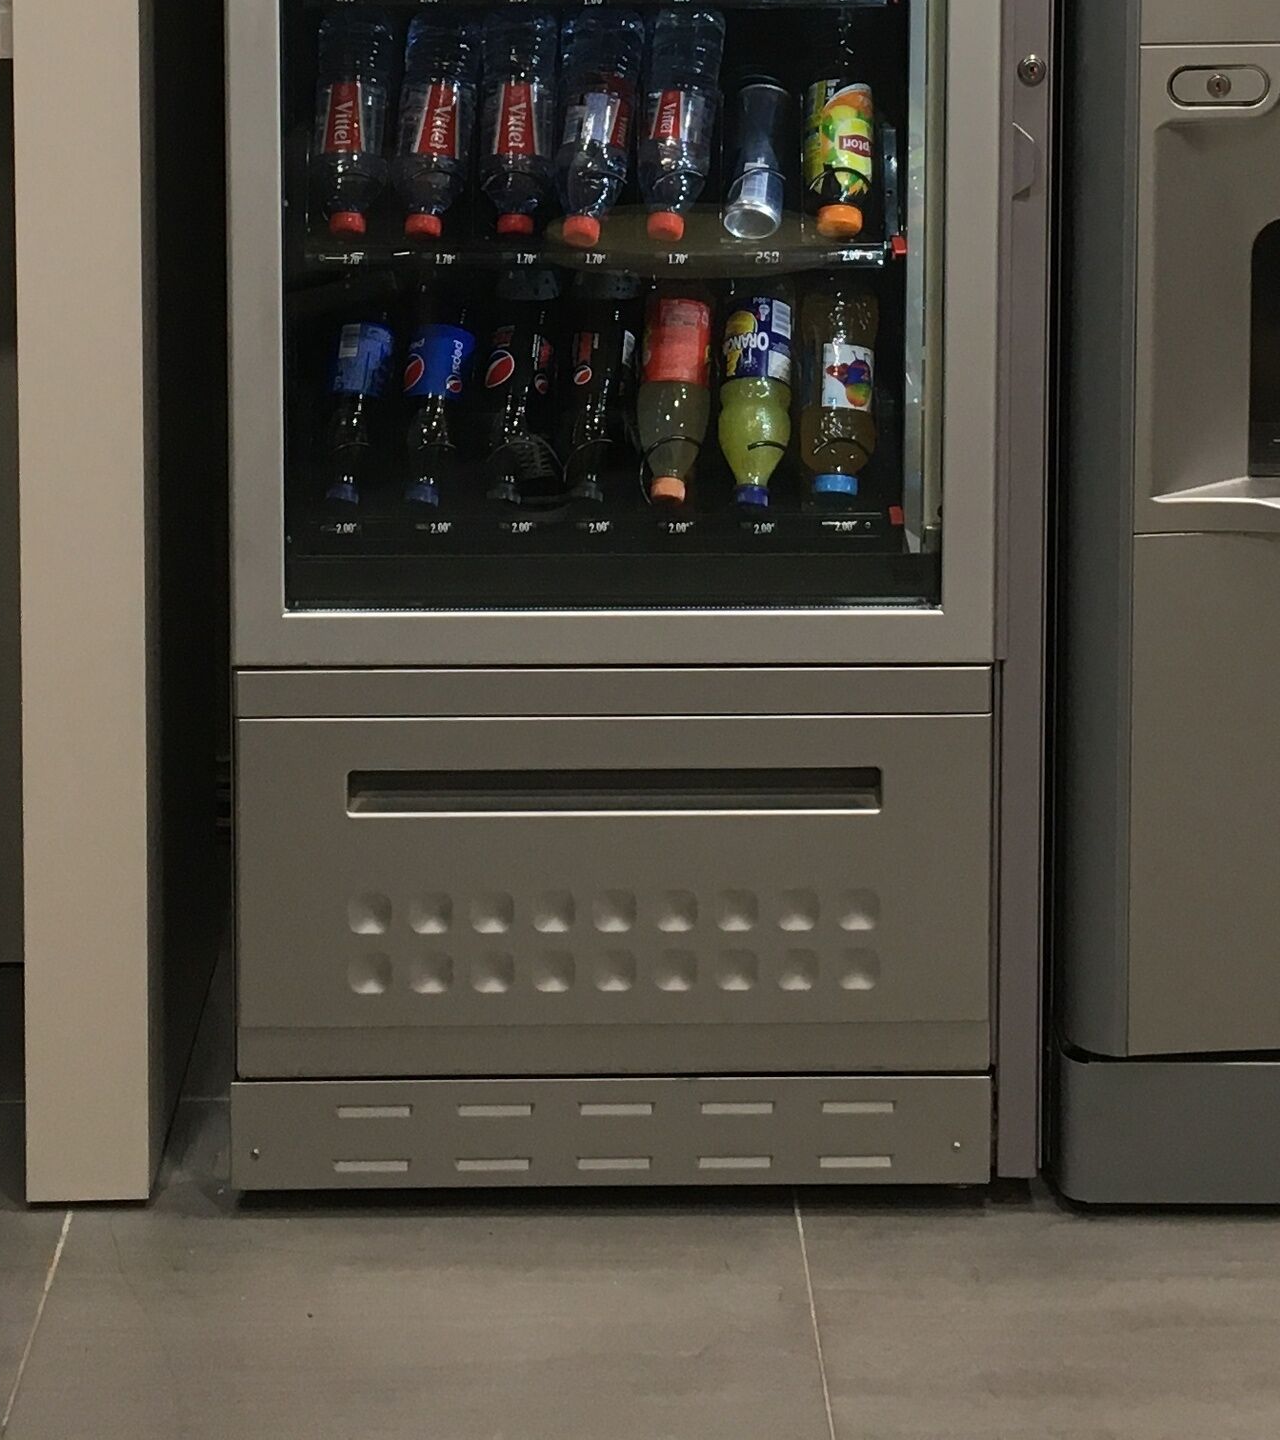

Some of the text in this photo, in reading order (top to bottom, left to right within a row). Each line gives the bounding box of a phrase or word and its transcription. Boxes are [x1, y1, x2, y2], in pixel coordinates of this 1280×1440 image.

[334, 100, 354, 145] Vittel
[429, 105, 452, 149] Vittel
[507, 102, 527, 149] Vittel
[452, 339, 464, 375] pepsi
